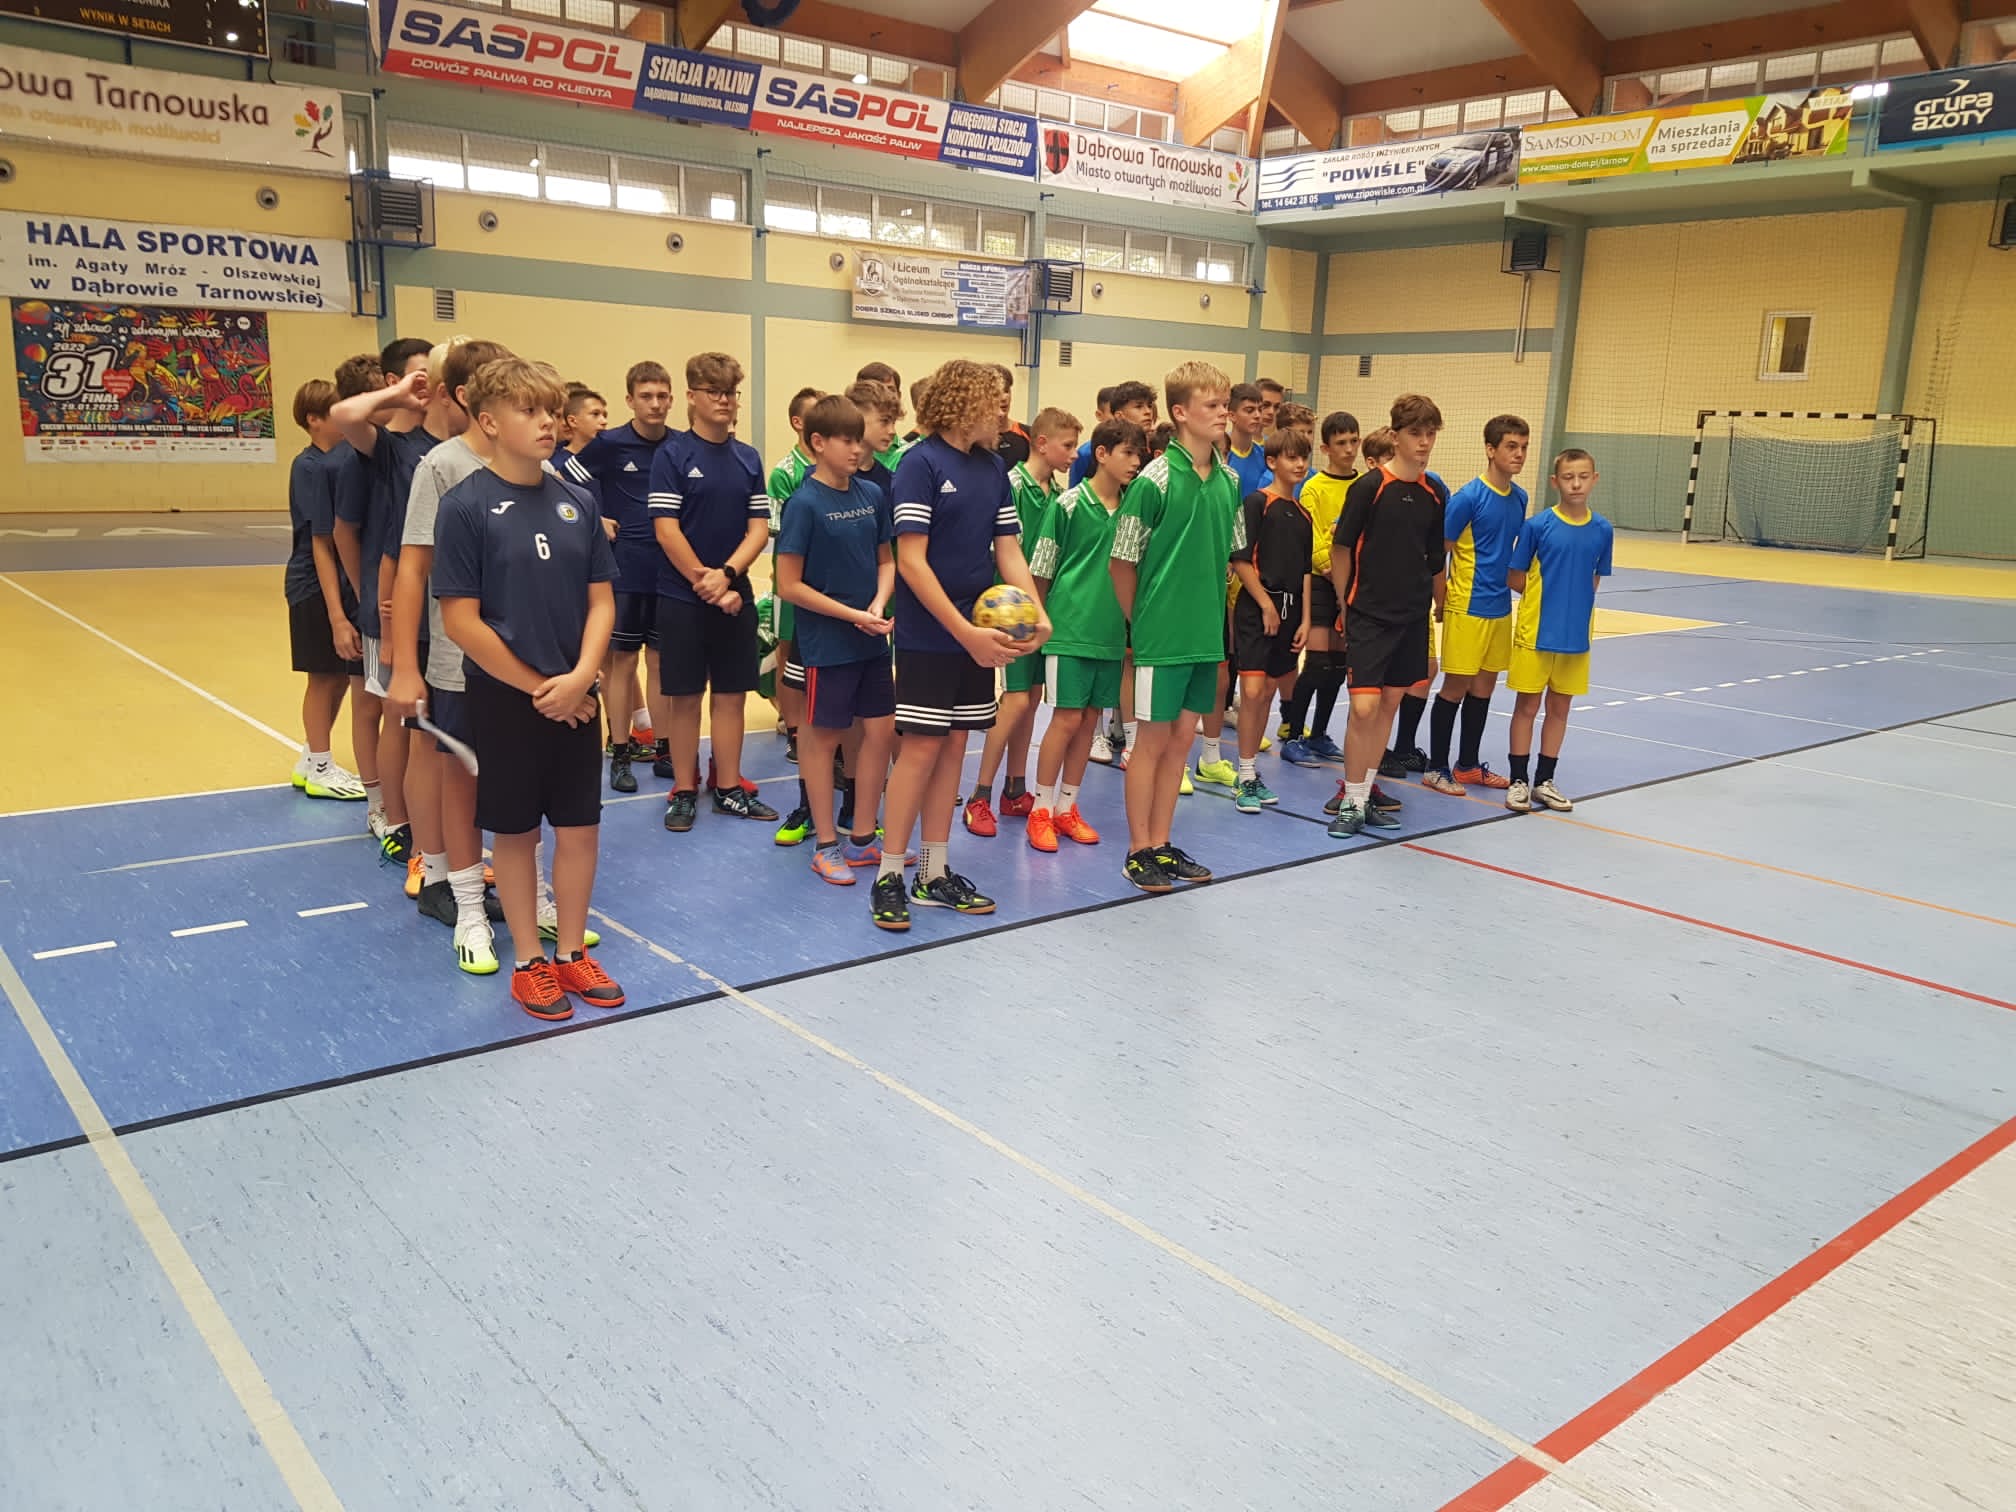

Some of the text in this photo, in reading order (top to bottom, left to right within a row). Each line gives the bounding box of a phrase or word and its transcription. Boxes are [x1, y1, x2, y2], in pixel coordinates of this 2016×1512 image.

[79, 7, 171, 33] WYNIK W SETACH
[400, 10, 632, 80] SASPOL
[411, 57, 613, 99] DOWÓZ PALIWA DO KLIENTA
[648, 55, 755, 96] STACJA PALIW
[85, 72, 268, 126] Tarnowska
[644, 86, 679, 102] DĄBROWA
[766, 77, 938, 134] SASPOL
[776, 118, 922, 151] NAJLEPSZA JAKOŚĆ PALIW
[950, 109, 1027, 138] OKRĘGOWA STACJA
[1658, 120, 1740, 141] Mieszkania
[946, 128, 988, 151] KONTROLI
[986, 137, 1032, 158] POJAZDÓW
[1076, 135, 1223, 178] Dąbrowa Tarnowska
[1651, 135, 1733, 155] na sprzedaż
[1076, 161, 1222, 198] Miasto otwartych możliwości
[26, 221, 319, 266] HALA SPORTOWA
[28, 254, 58, 268] im.
[75, 257, 128, 275] Agaty
[145, 263, 187, 276] Mróz
[223, 266, 321, 289] Olszewskiej
[897, 262, 930, 274] Liceum
[30, 276, 323, 308] w Dąbrowie Tarnowskiej
[52, 342, 86, 352] 2023
[43, 347, 117, 399] 31
[534, 532, 551, 560] 6
[724, 797, 748, 814] FILA
